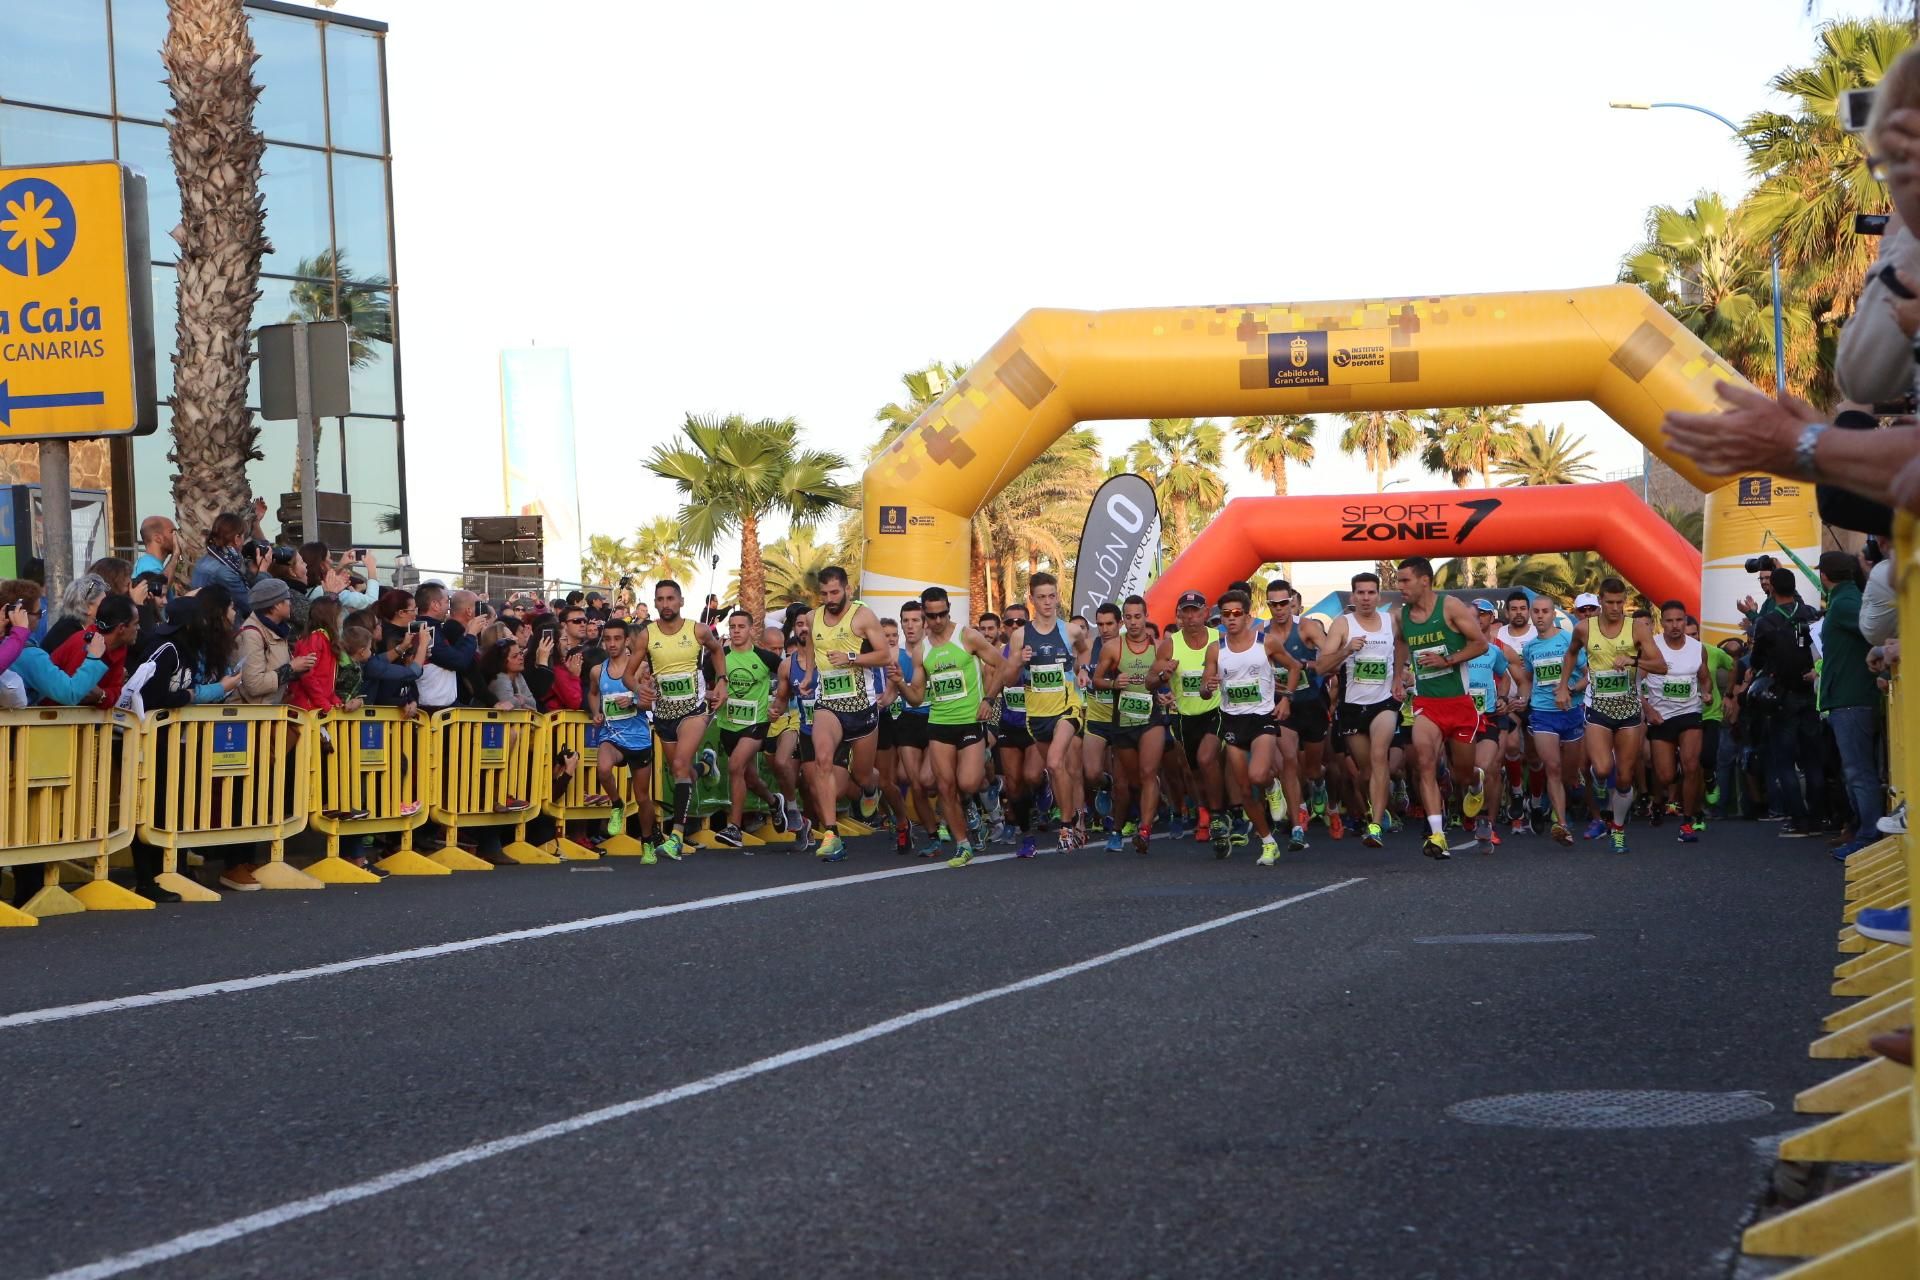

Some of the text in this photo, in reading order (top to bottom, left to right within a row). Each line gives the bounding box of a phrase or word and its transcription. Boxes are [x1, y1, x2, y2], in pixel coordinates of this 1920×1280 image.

[19, 297, 102, 334] Caja
[3, 339, 105, 361] CANARIAS
[1274, 376, 1325, 385] Gran Canaria
[1278, 370, 1308, 378] Cabildo
[1342, 503, 1449, 522] SPORT
[1341, 522, 1450, 542] ZONE
[1080, 532, 1129, 628] CAJÓN
[1355, 662, 1386, 675] 7423
[1535, 664, 1563, 678] 8709
[823, 675, 852, 690] 9511
[1033, 671, 1063, 683] 6002
[1596, 676, 1626, 689] 9247
[661, 678, 691, 692] 6001
[933, 678, 962, 693] 8749
[1663, 683, 1691, 694] 6439
[1227, 686, 1259, 699] 8094
[728, 704, 755, 717] 9711
[1121, 697, 1151, 711] 7333
